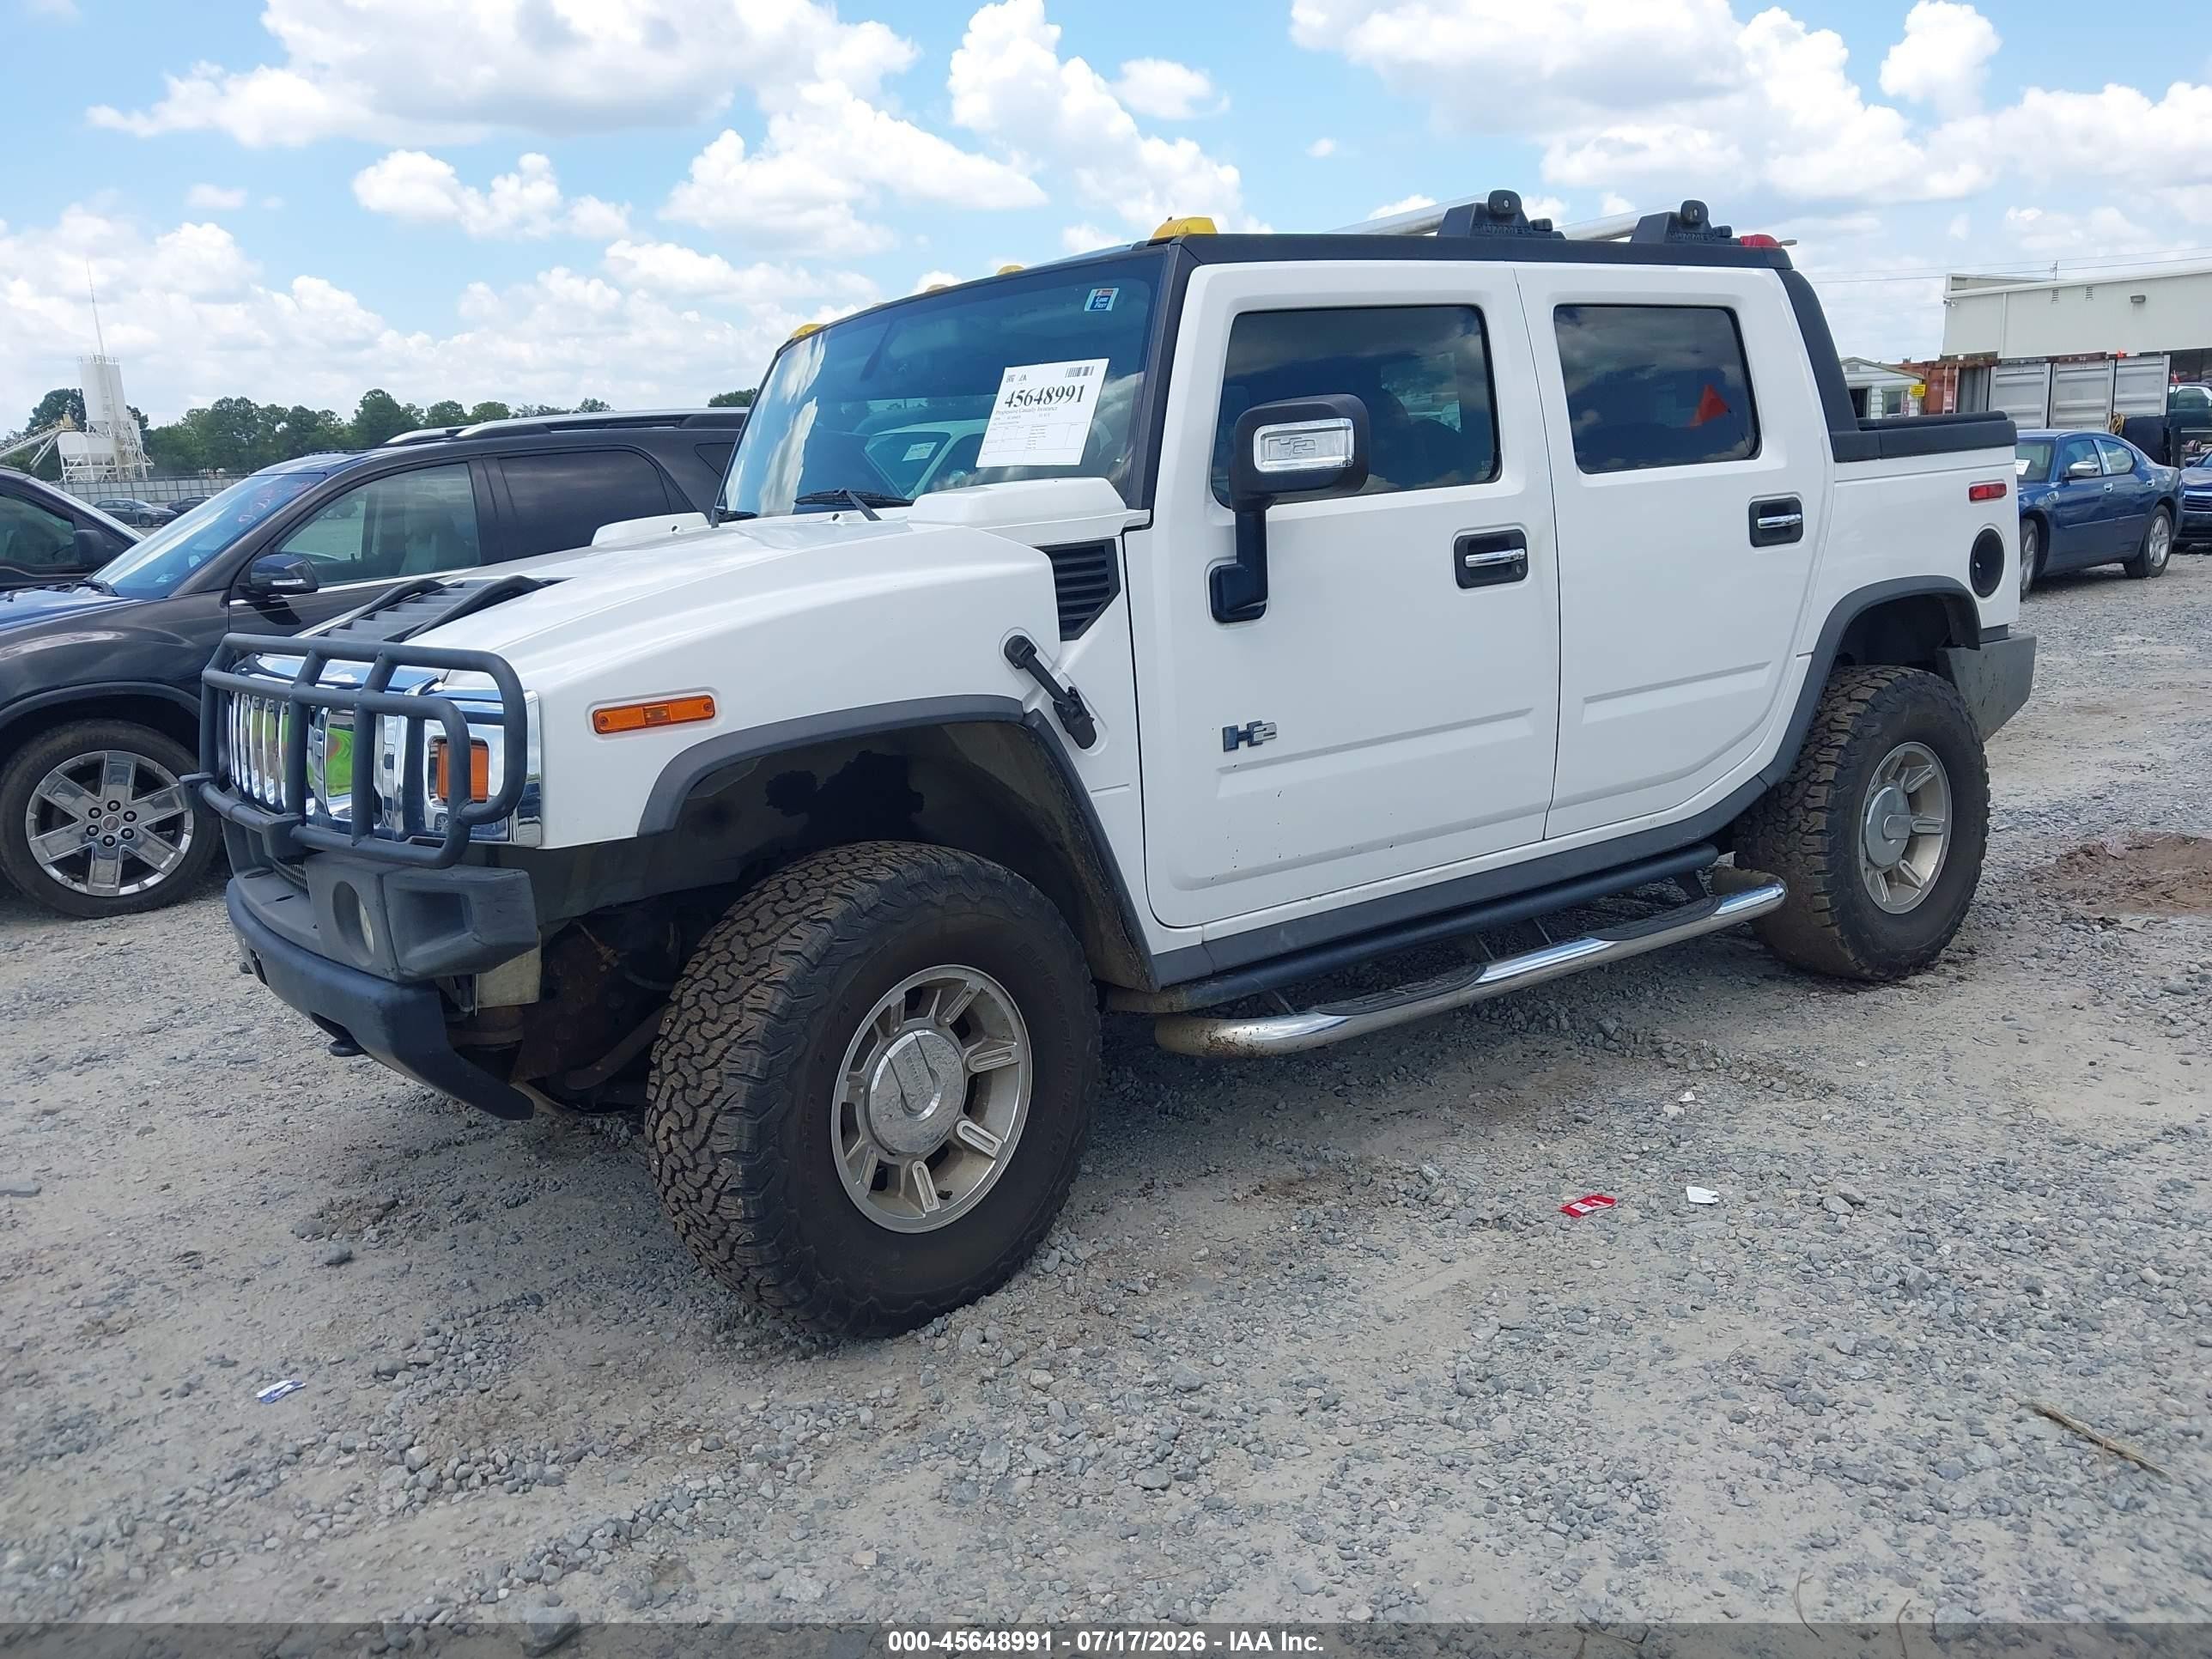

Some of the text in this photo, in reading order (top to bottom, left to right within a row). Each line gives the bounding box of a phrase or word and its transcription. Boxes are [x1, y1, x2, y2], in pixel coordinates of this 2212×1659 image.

[1474, 223, 1533, 234] HUMMER
[1005, 384, 1085, 408] 45648991
[1267, 436, 1317, 460] H2
[1222, 720, 1278, 752] H2
